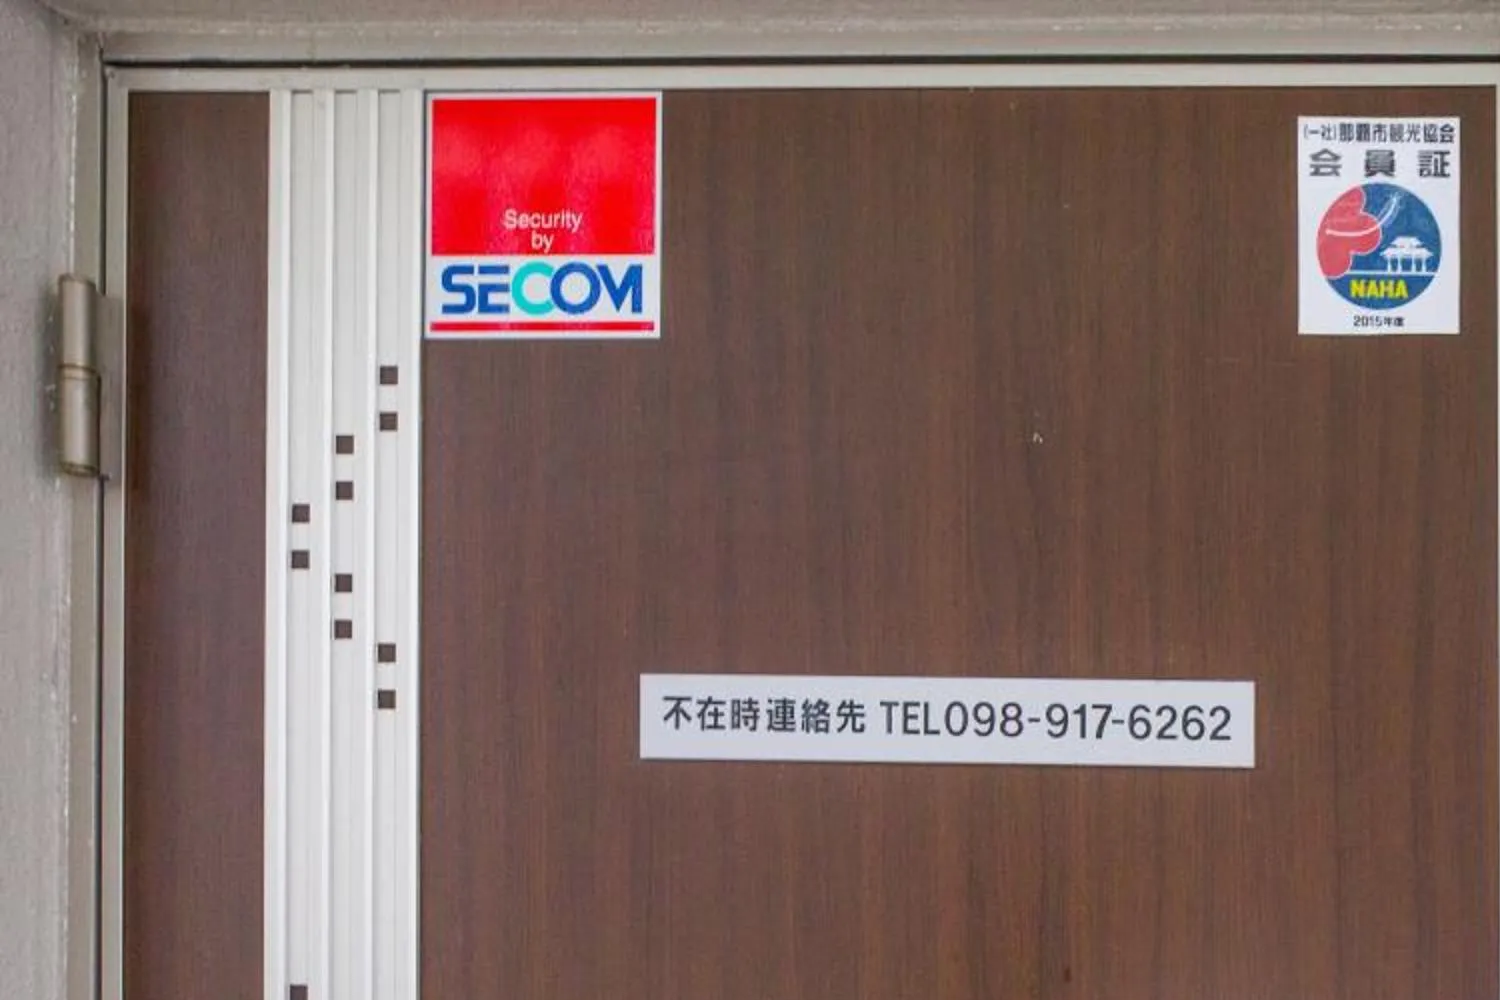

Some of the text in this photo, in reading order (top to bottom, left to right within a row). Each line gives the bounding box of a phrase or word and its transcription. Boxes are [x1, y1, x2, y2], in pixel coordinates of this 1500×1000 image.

[1309, 148, 1451, 178] 会員証
[503, 208, 583, 234] Security
[531, 230, 554, 254] by
[440, 261, 643, 316] SECOM
[1350, 279, 1409, 299] NAHA
[1353, 315, 1405, 328] 2015年度
[662, 695, 1233, 741] 不在時連絡先 TEL098-917-6262
